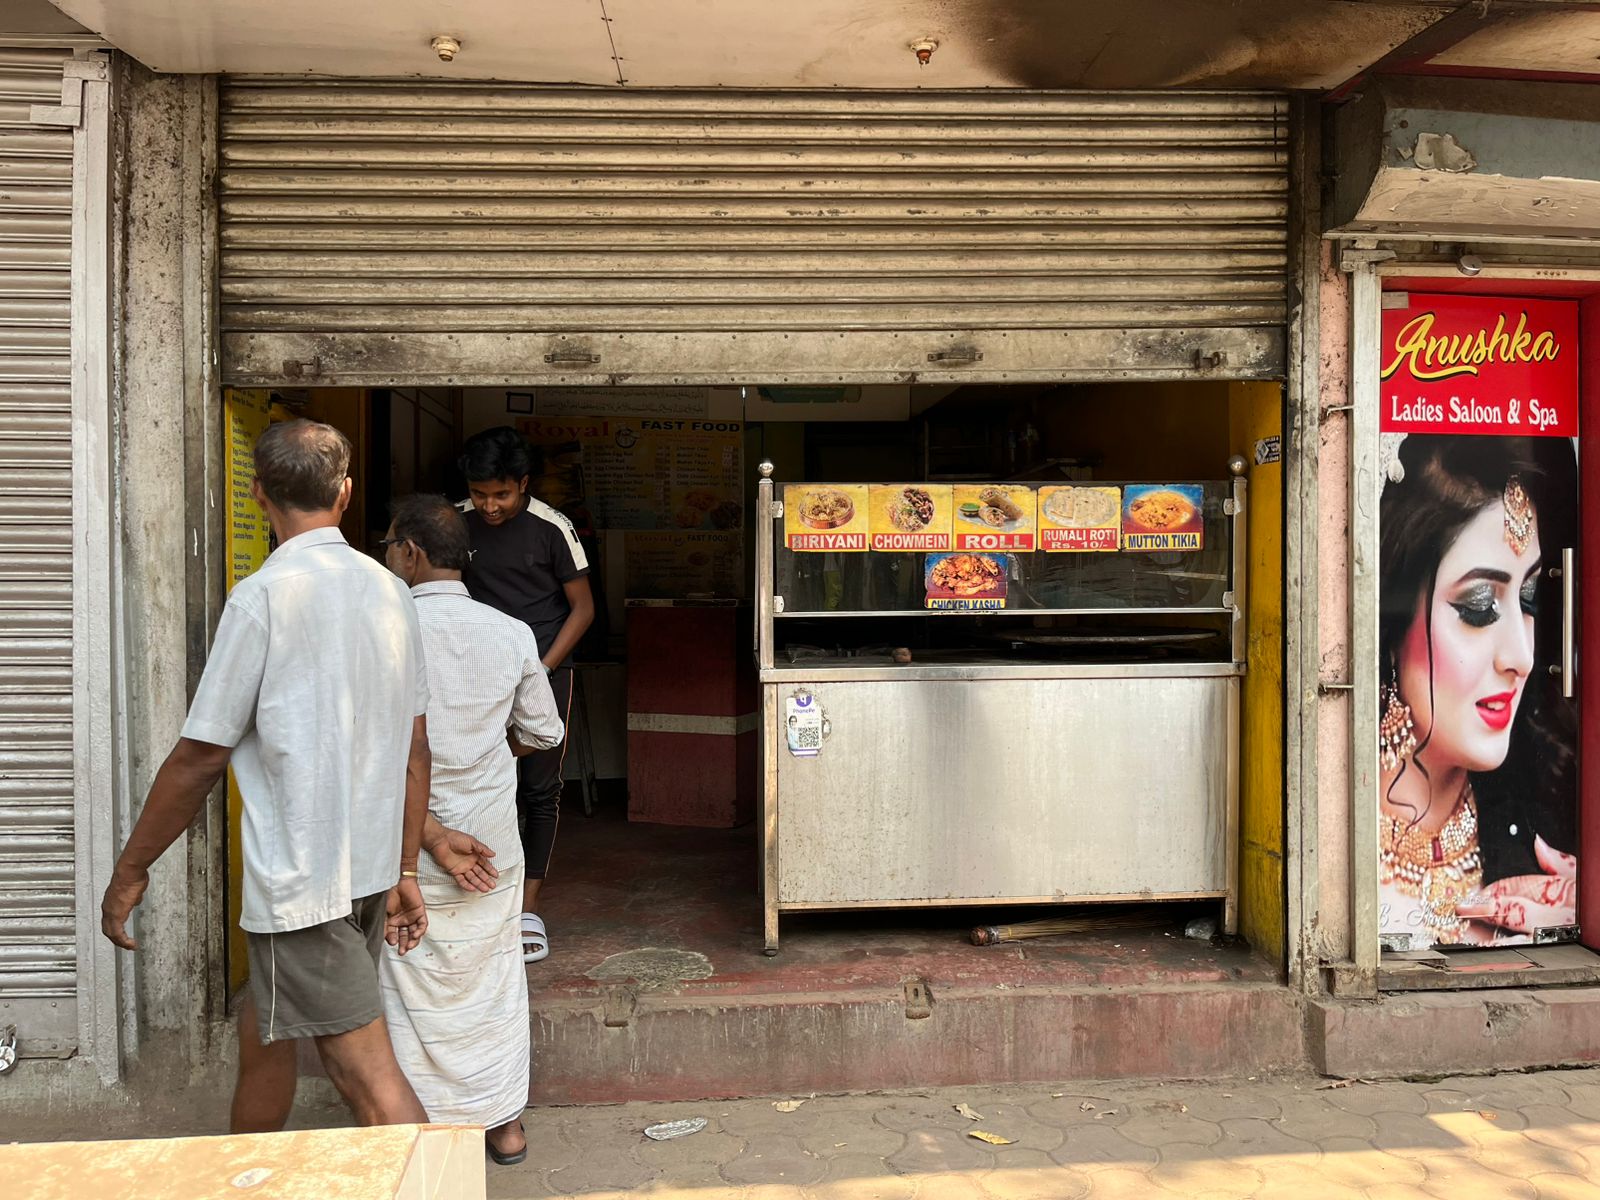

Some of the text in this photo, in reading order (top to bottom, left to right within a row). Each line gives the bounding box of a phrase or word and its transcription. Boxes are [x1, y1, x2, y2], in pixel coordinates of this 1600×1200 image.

[1381, 311, 1559, 379] Anushka
[1391, 396, 1558, 430] Ladies Saloon & Spa
[522, 420, 608, 439] Royal
[641, 421, 740, 432] FAST FOOD
[792, 535, 864, 549] BIRIYANI
[874, 534, 948, 549] CHOWMEIN
[964, 535, 1028, 549] ROLL
[1043, 529, 1116, 542] RUMALI ROTI
[1128, 534, 1198, 549] MUTTON TIKIA
[1051, 541, 1109, 550] Rs. 10/-
[931, 599, 1004, 609] CHICKEN KASHA
